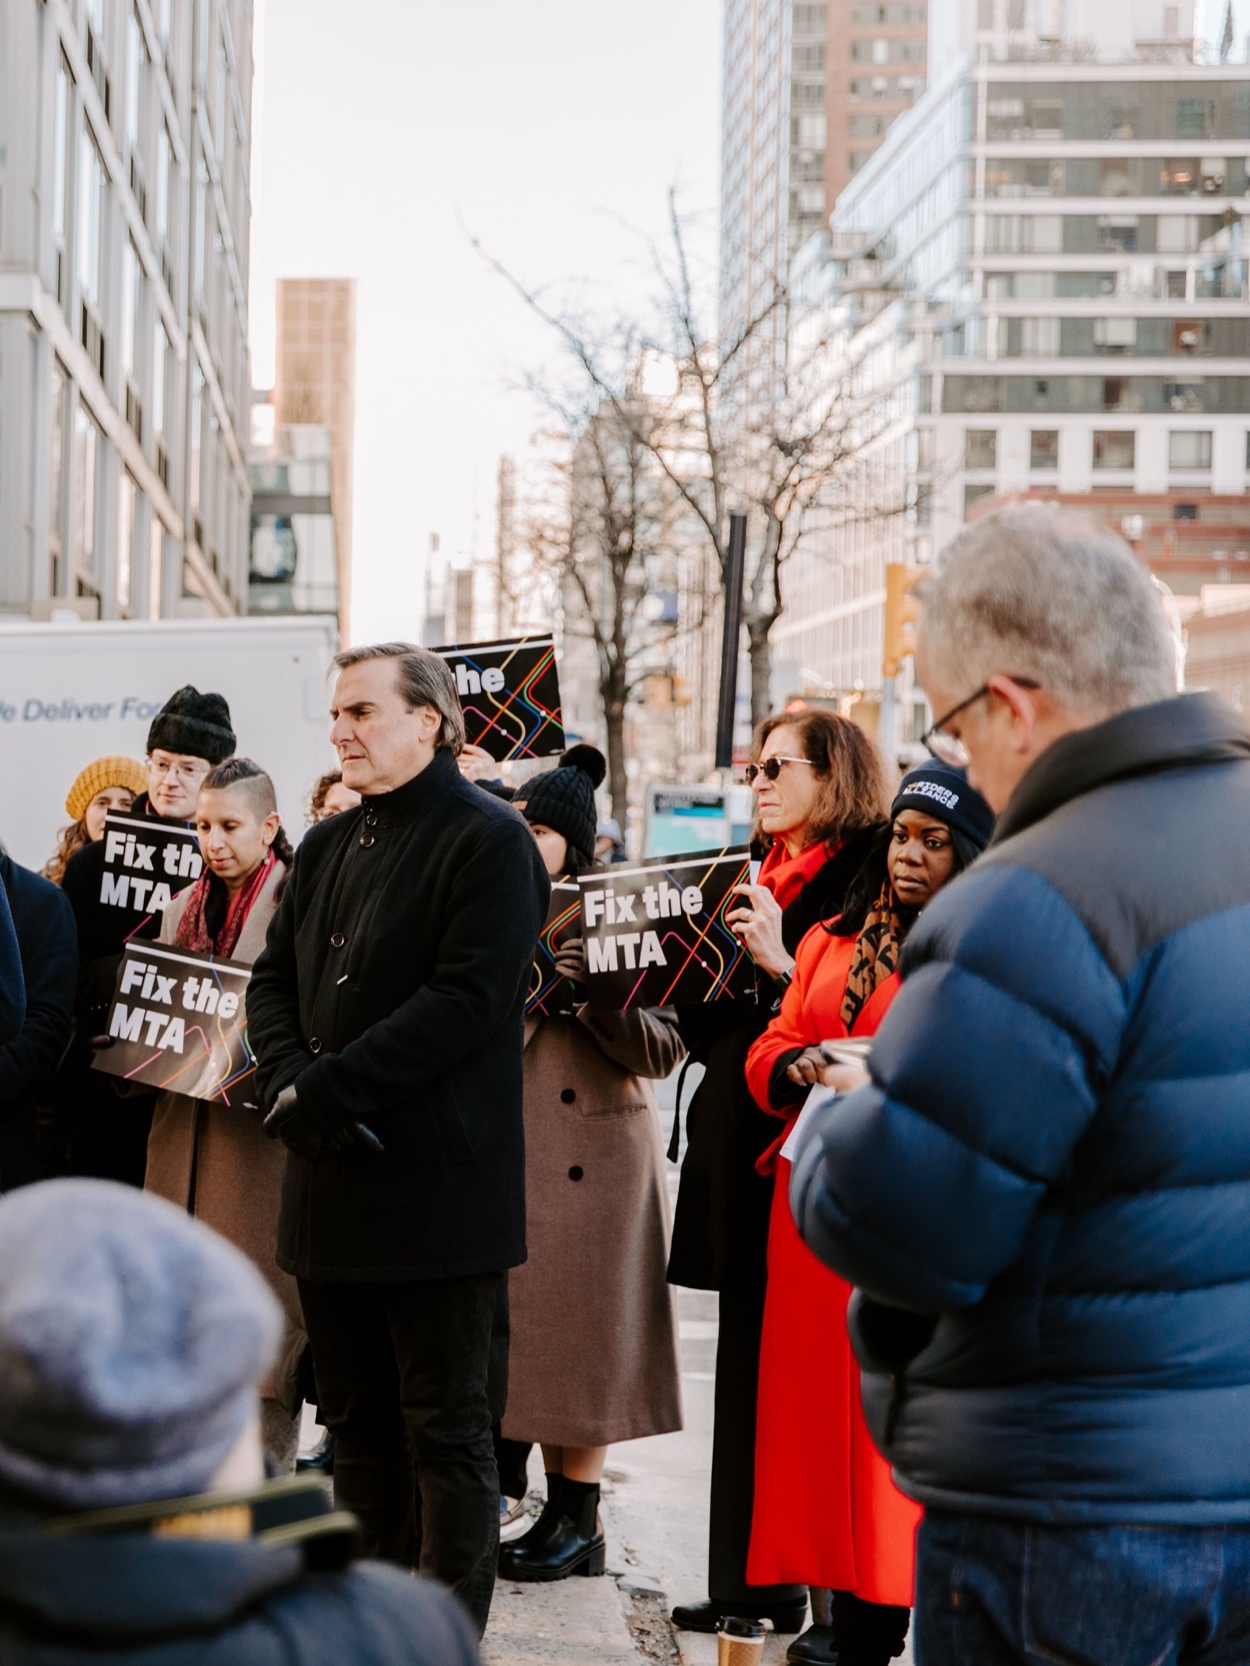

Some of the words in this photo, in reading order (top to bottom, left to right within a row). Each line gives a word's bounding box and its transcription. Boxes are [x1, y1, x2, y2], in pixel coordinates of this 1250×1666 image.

[451, 664, 505, 696] he
[22, 698, 112, 722] Deliver
[902, 786, 956, 810] ALLIANCE
[917, 781, 959, 803] RIDERS
[104, 830, 155, 871] Fix
[162, 843, 203, 879] th
[100, 871, 173, 914] MTA
[584, 889, 637, 927] Fix
[642, 881, 703, 920] the
[587, 930, 667, 974] MTA
[119, 959, 178, 1004] Fix
[182, 976, 239, 1019] the
[109, 1002, 185, 1054] MTA
